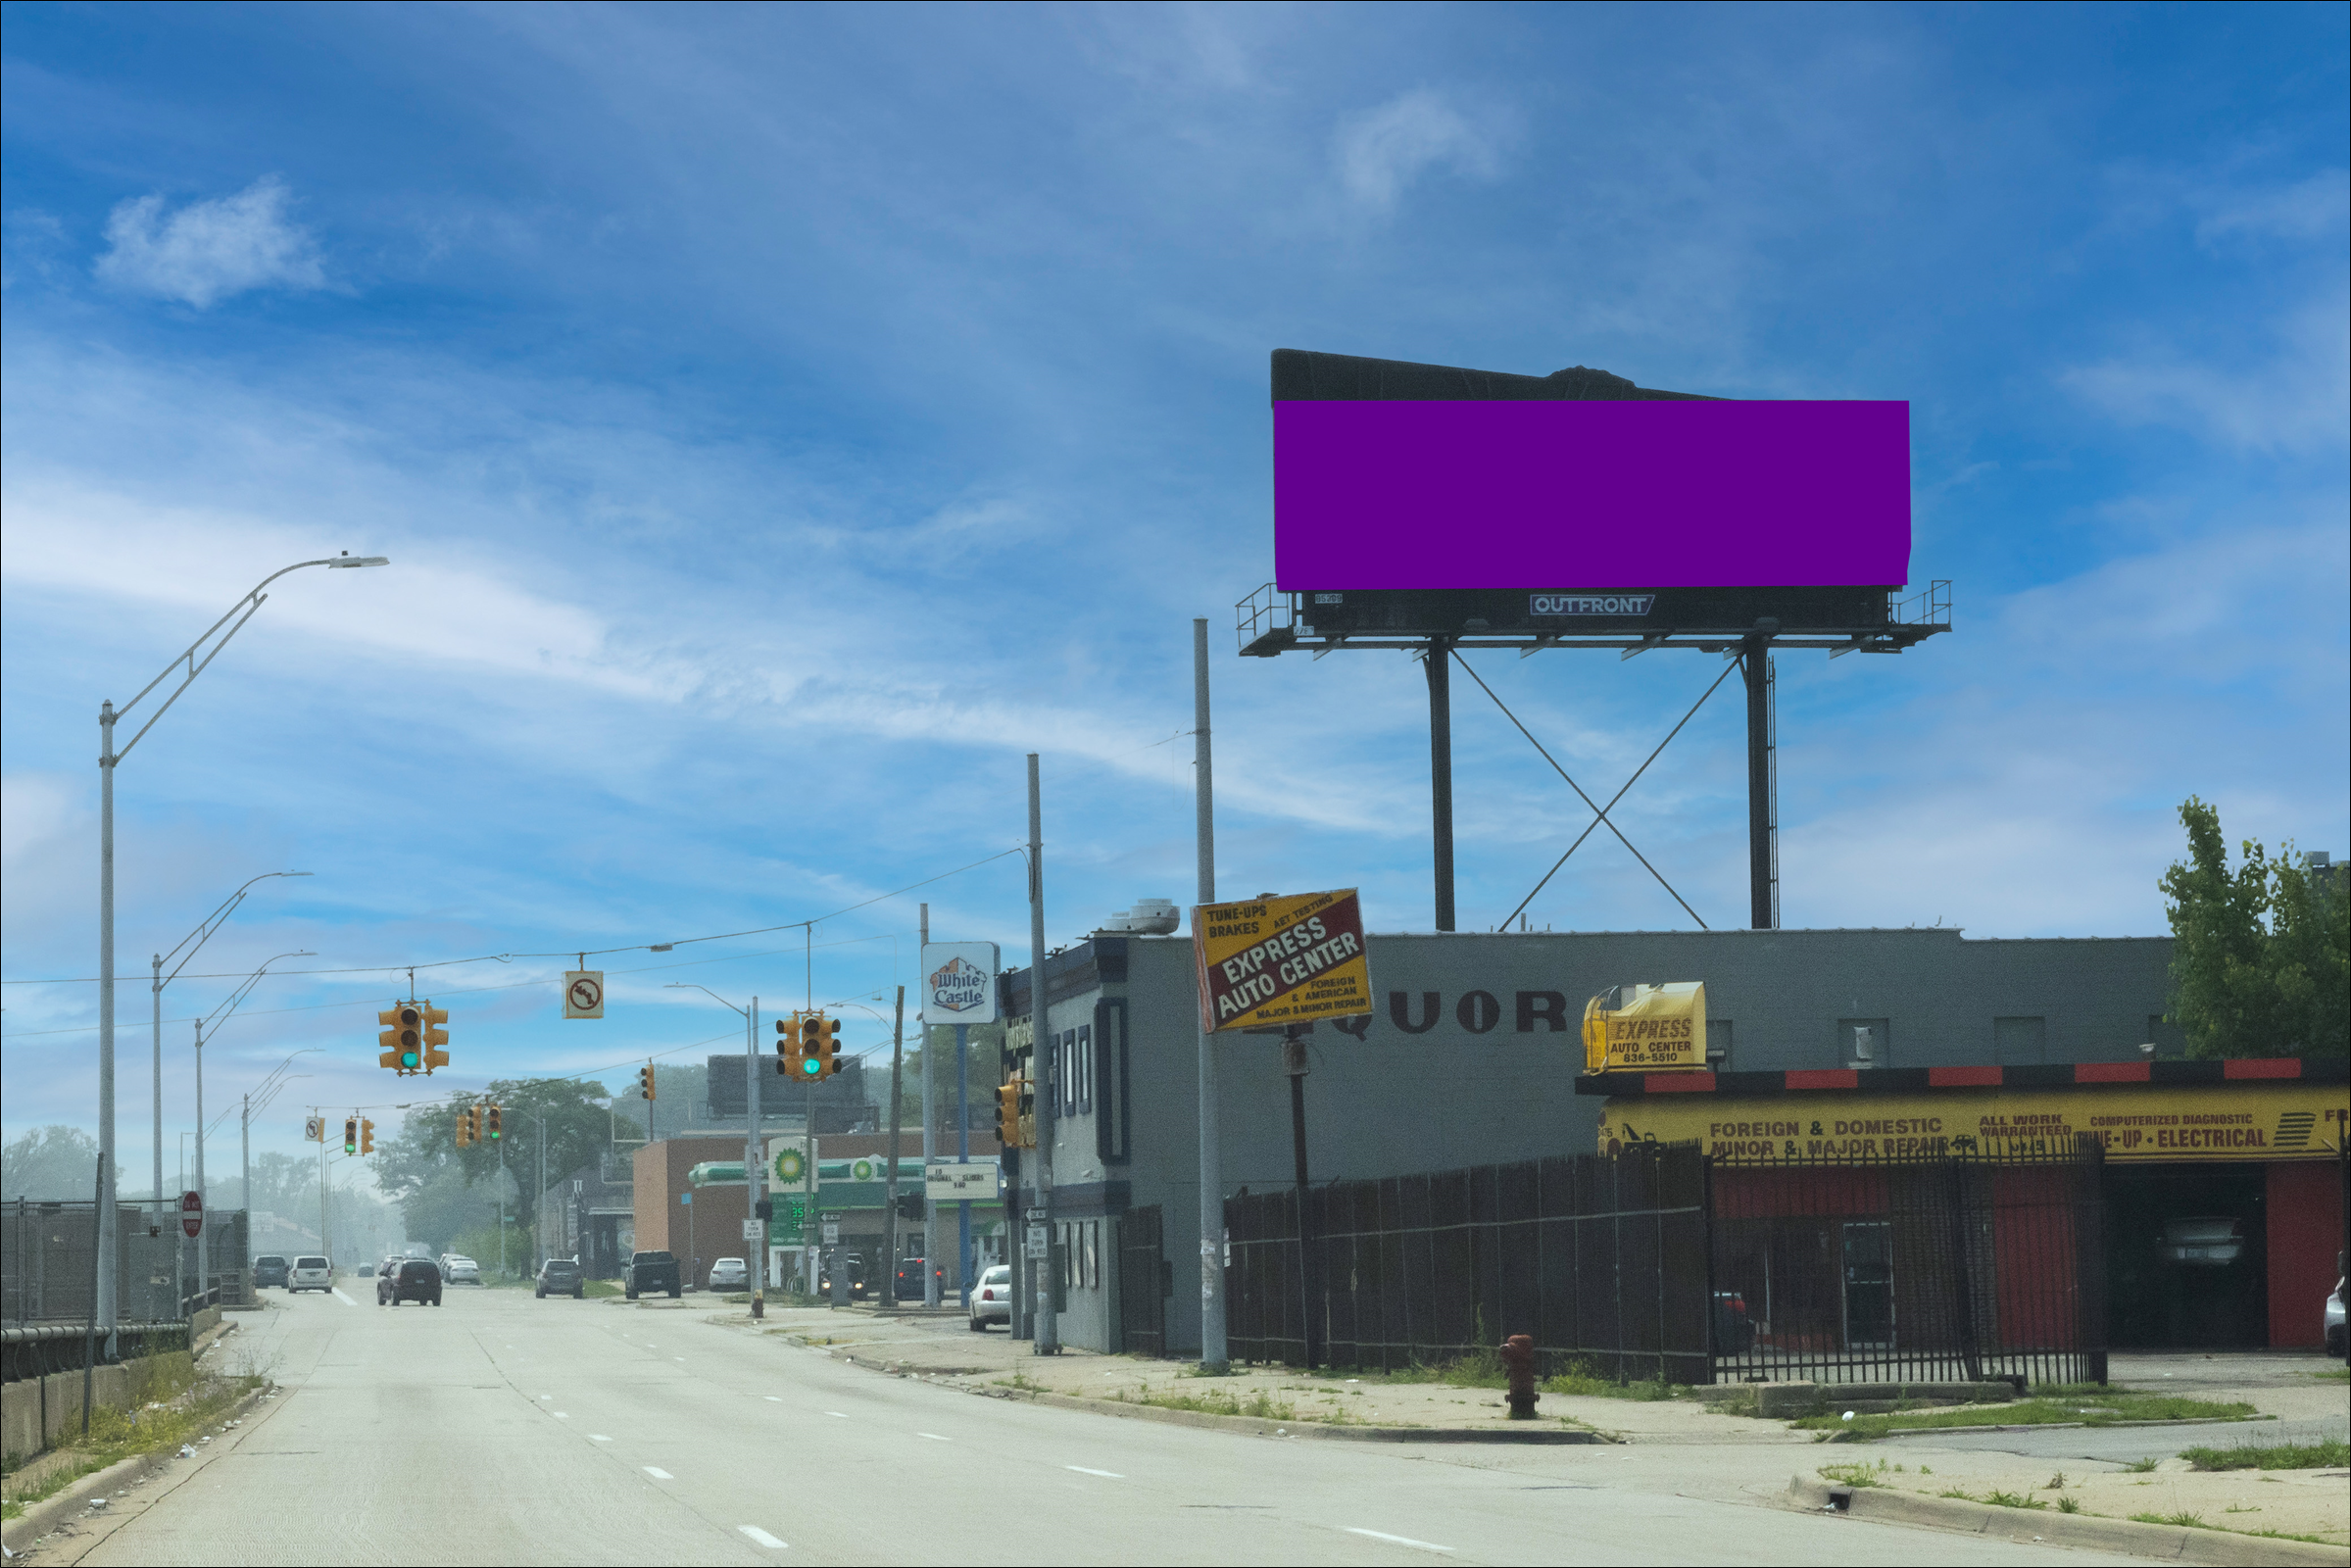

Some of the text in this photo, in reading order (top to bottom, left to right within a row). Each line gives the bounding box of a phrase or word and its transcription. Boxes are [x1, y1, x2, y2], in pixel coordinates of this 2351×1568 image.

[1535, 596, 1648, 613] OUTFRONT
[1206, 904, 1267, 922] TUNE-UPS
[1292, 894, 1334, 919] TESTING
[1208, 921, 1259, 938] BRAKES
[1222, 916, 1326, 984] EXPRESS
[938, 973, 980, 990] White
[1218, 932, 1359, 1019] AUTO CENTER
[1310, 976, 1355, 990] FOREIGN
[934, 990, 983, 1004] Castle
[1292, 986, 1357, 1003] & AMERICAN
[1256, 1006, 1291, 1019] MAJOR
[1300, 1002, 1333, 1015] MINOR
[1334, 998, 1367, 1010] REPAIR
[1615, 1018, 1691, 1039] EXPRESS
[1610, 1041, 1691, 1053] AUTO CENTER
[1623, 1053, 1678, 1062] 836-5510
[1710, 1117, 1942, 1137] FOREIGN & DOMESTIC
[1980, 1114, 2063, 1126] ALL WORK
[2090, 1113, 2253, 1126] COMPUTERIZED DIAGNOSTIC
[1711, 1137, 1950, 1155] MINOR & MAJOR REPAIR
[2158, 1128, 2268, 1148] ELECTRICAL
